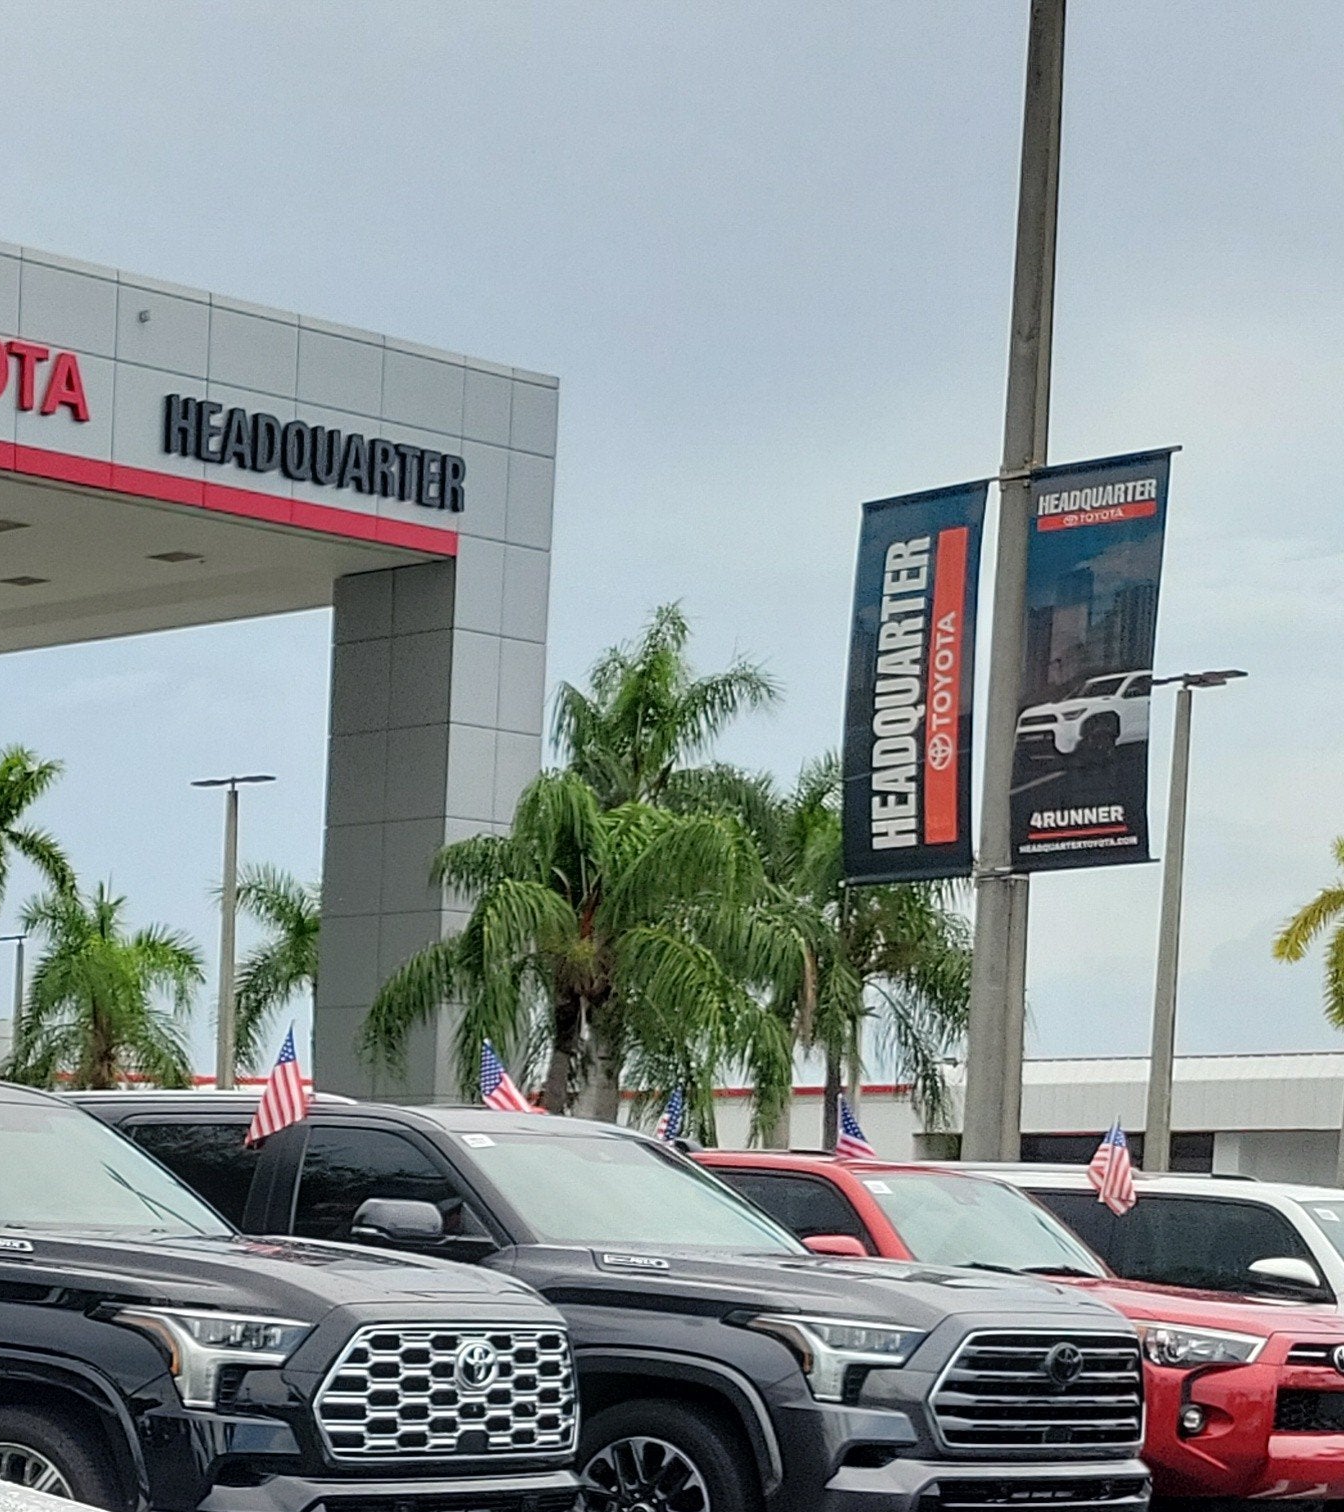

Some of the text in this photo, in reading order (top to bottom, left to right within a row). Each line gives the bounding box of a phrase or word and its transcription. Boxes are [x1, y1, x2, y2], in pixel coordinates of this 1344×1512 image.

[163, 393, 466, 513] HEADQUARTER
[1037, 478, 1157, 516] HEADQUARTER
[1080, 507, 1124, 523] TOYOTA
[871, 534, 932, 851] HEADQUARTER
[929, 609, 958, 732] TOYOTA
[1029, 804, 1125, 829] 4RUNNER
